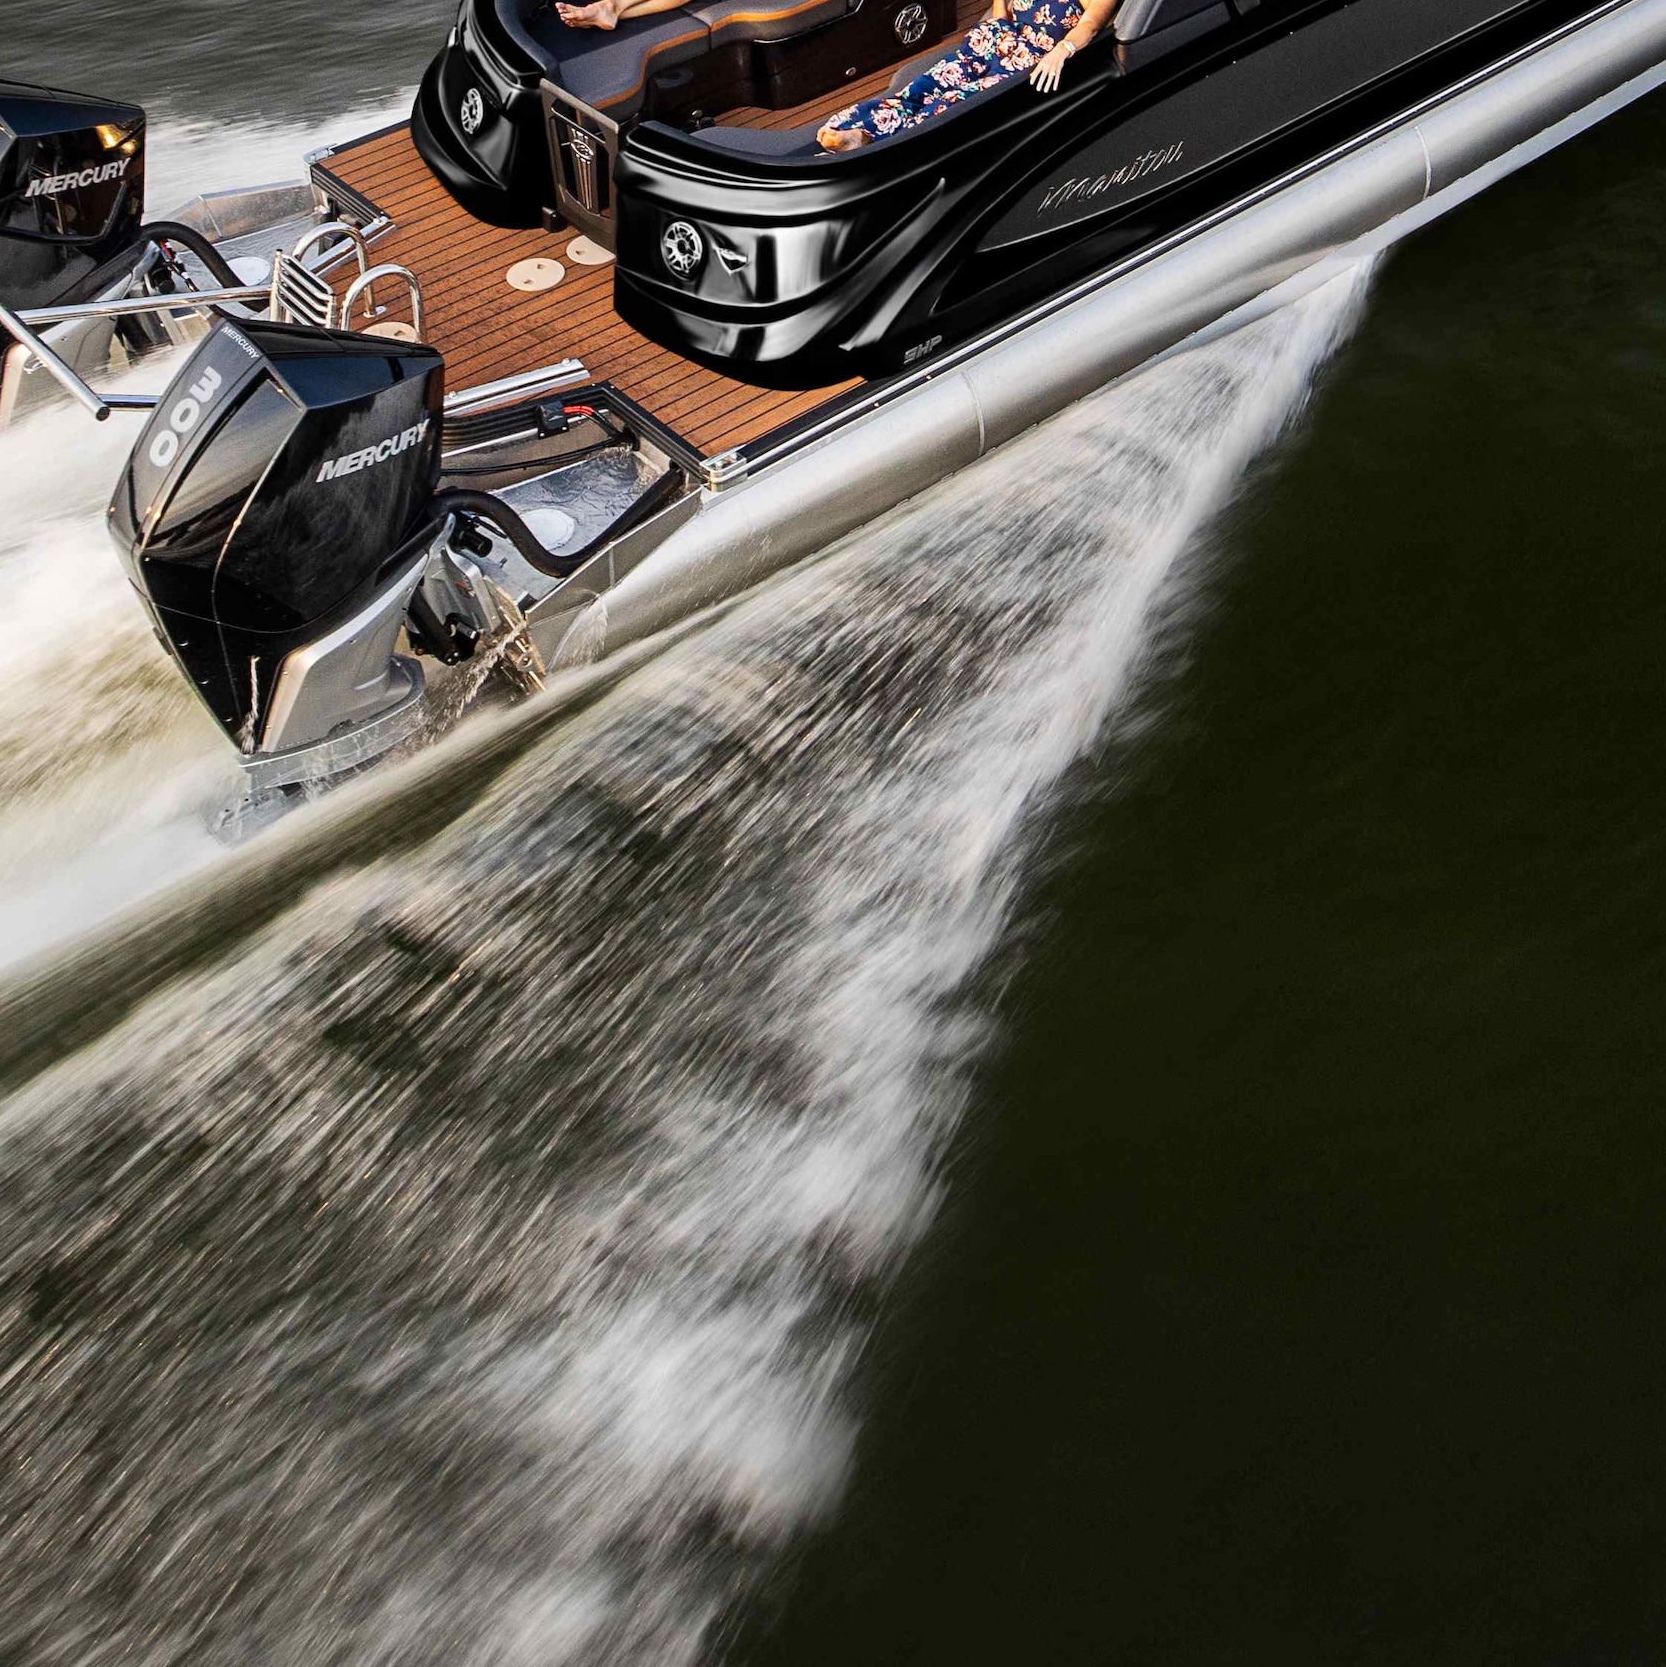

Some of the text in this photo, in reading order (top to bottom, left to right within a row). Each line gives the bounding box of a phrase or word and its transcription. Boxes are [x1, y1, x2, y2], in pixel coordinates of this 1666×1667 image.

[24, 157, 131, 197] MERCURY
[220, 326, 260, 359] MERCURY
[903, 335, 942, 364] SHP
[315, 418, 431, 483] MERCURY
